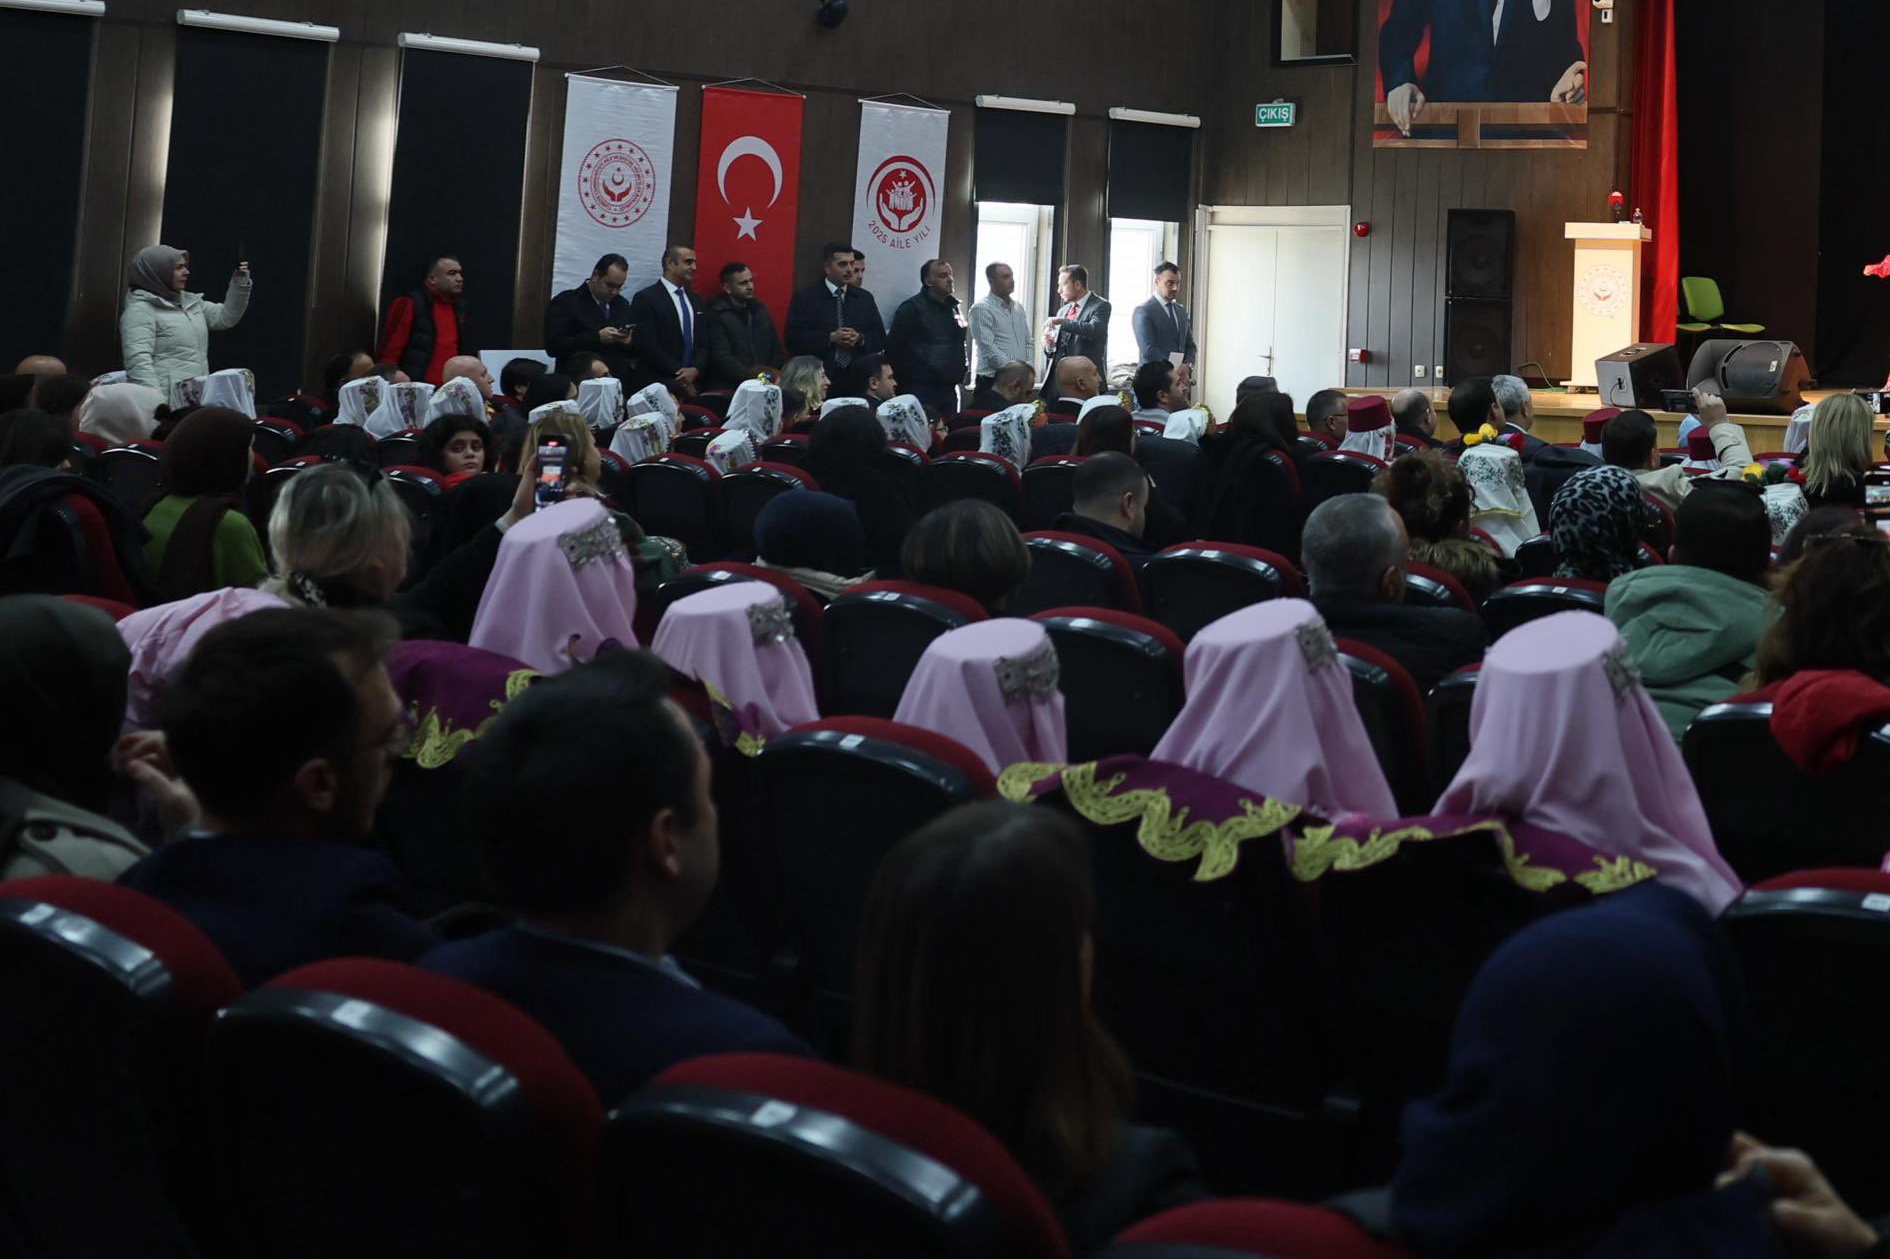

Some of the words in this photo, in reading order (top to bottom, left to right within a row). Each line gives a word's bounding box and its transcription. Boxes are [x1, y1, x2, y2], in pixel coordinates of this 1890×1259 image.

[1259, 107, 1289, 122] ÇIKIŞ
[868, 220, 888, 244] 2025
[913, 225, 931, 244] YILI
